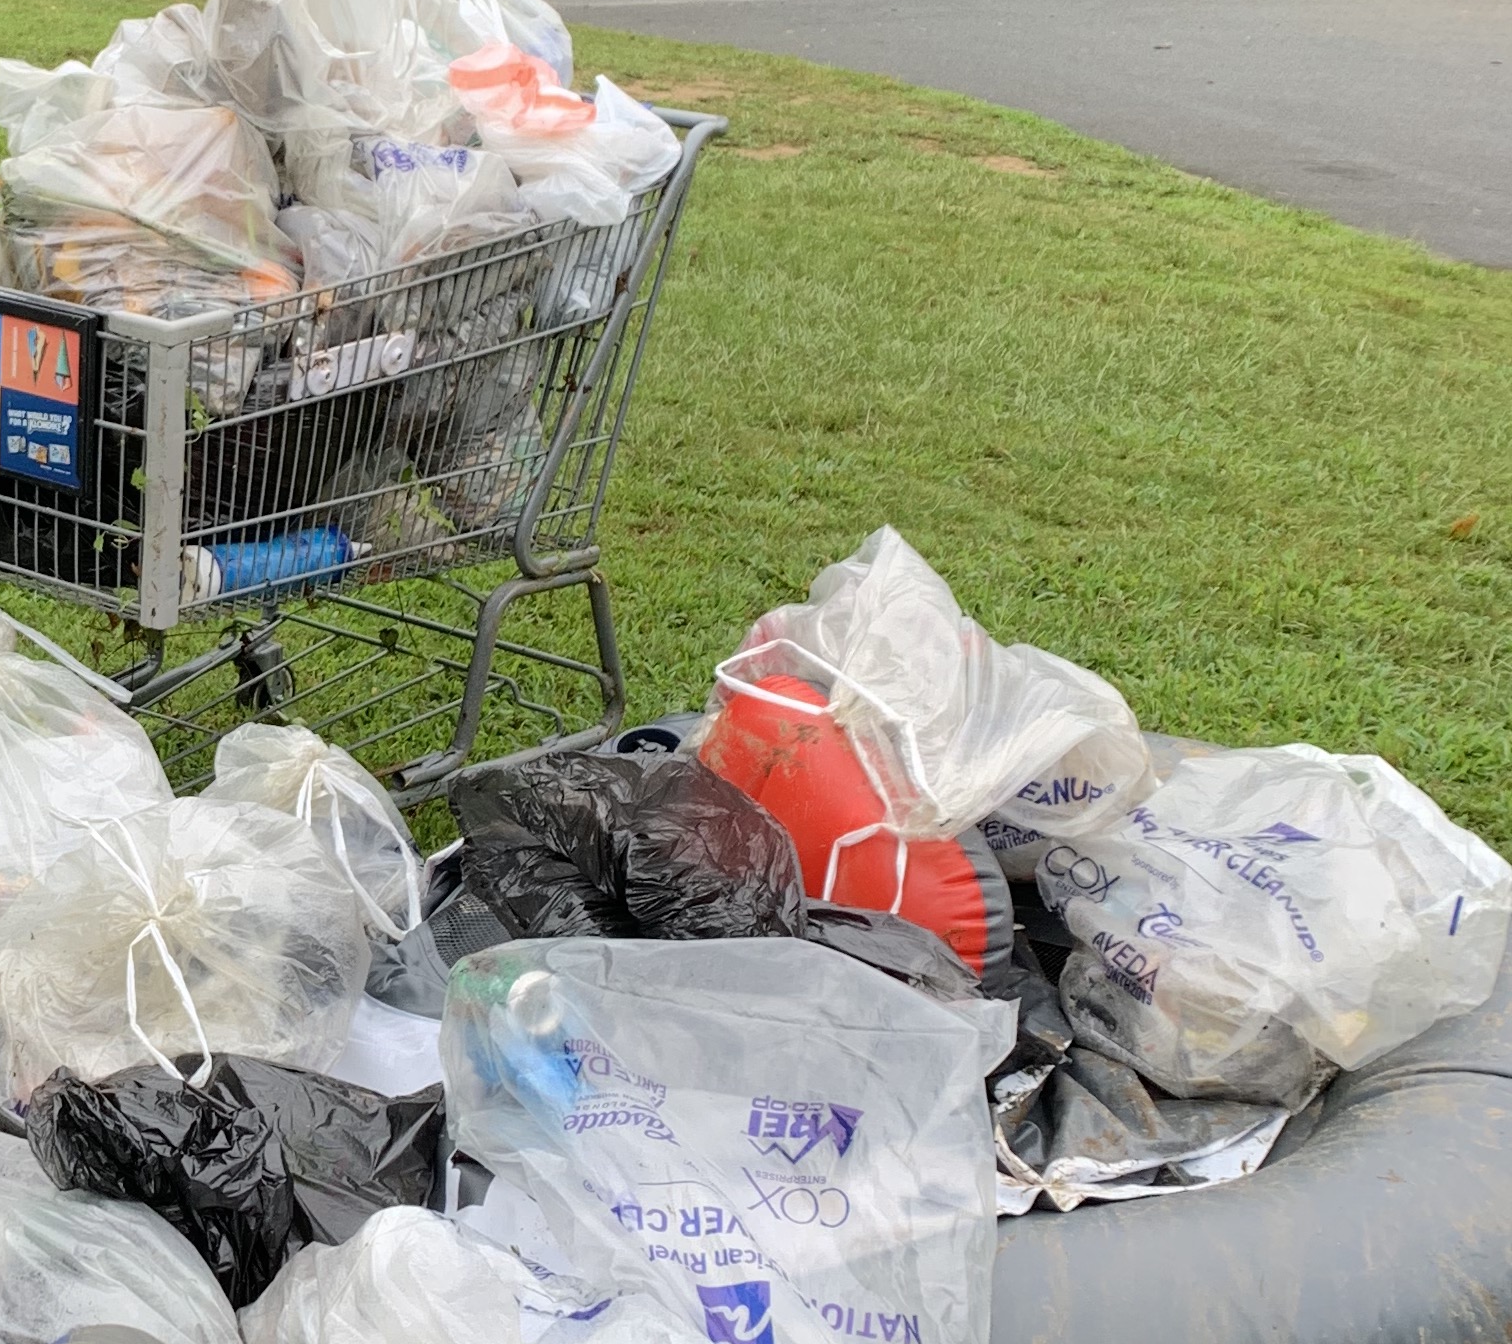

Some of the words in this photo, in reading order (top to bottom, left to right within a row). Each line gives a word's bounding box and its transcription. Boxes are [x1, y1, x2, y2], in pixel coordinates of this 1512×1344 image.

[1045, 845, 1121, 904] COX
[1131, 853, 1171, 883] Sponsored
[1091, 931, 1160, 992] AVEDA
[576, 1101, 627, 1111] BLONDE
[564, 1109, 681, 1147] Cascade
[748, 1109, 820, 1138] REI
[755, 1170, 827, 1185] ENTERPRISES
[741, 1166, 850, 1228] COX
